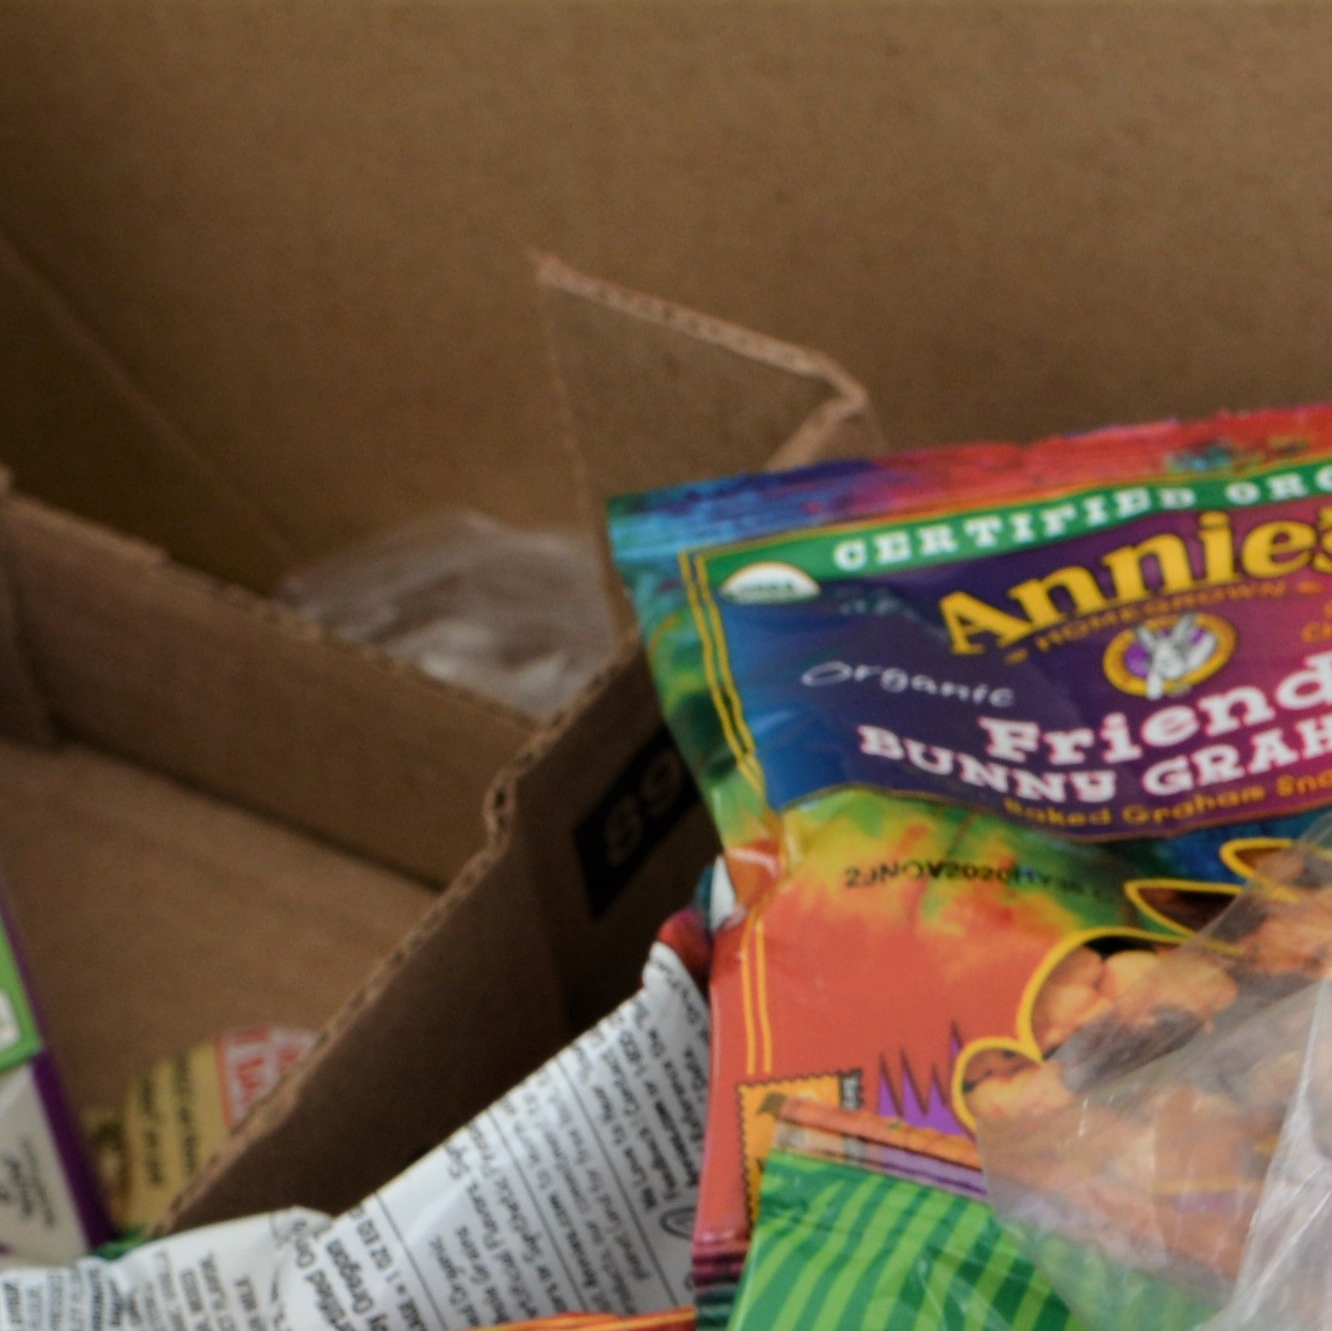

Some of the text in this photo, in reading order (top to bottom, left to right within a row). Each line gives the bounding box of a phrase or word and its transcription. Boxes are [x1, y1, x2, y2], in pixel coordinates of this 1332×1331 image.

[834, 483, 1197, 571] CERTIFIED
[801, 660, 1014, 707] Organic
[859, 723, 1117, 803] BUNNY
[1122, 789, 1267, 827] Graham
